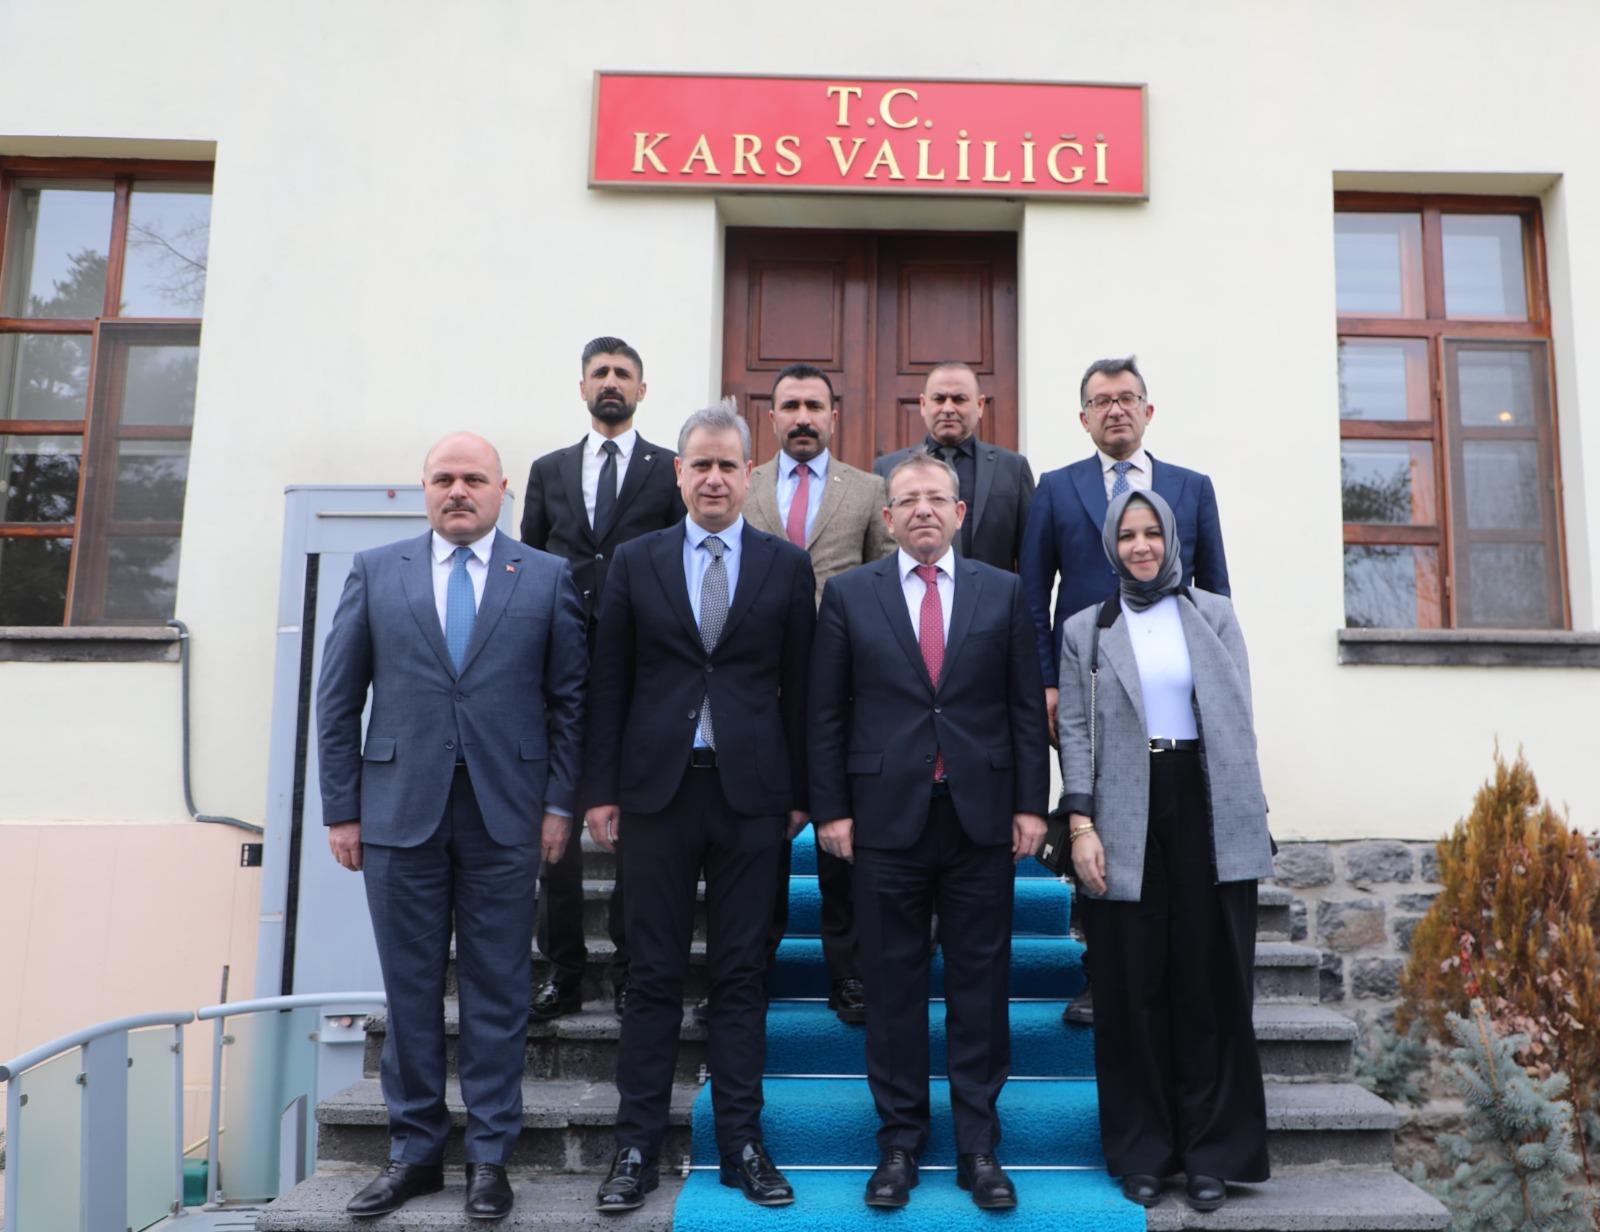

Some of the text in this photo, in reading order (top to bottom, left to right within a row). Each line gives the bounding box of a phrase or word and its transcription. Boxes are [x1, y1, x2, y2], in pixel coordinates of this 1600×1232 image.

[827, 85, 933, 129] T.C.
[632, 130, 1109, 185] KARS VALİLİĞİ
